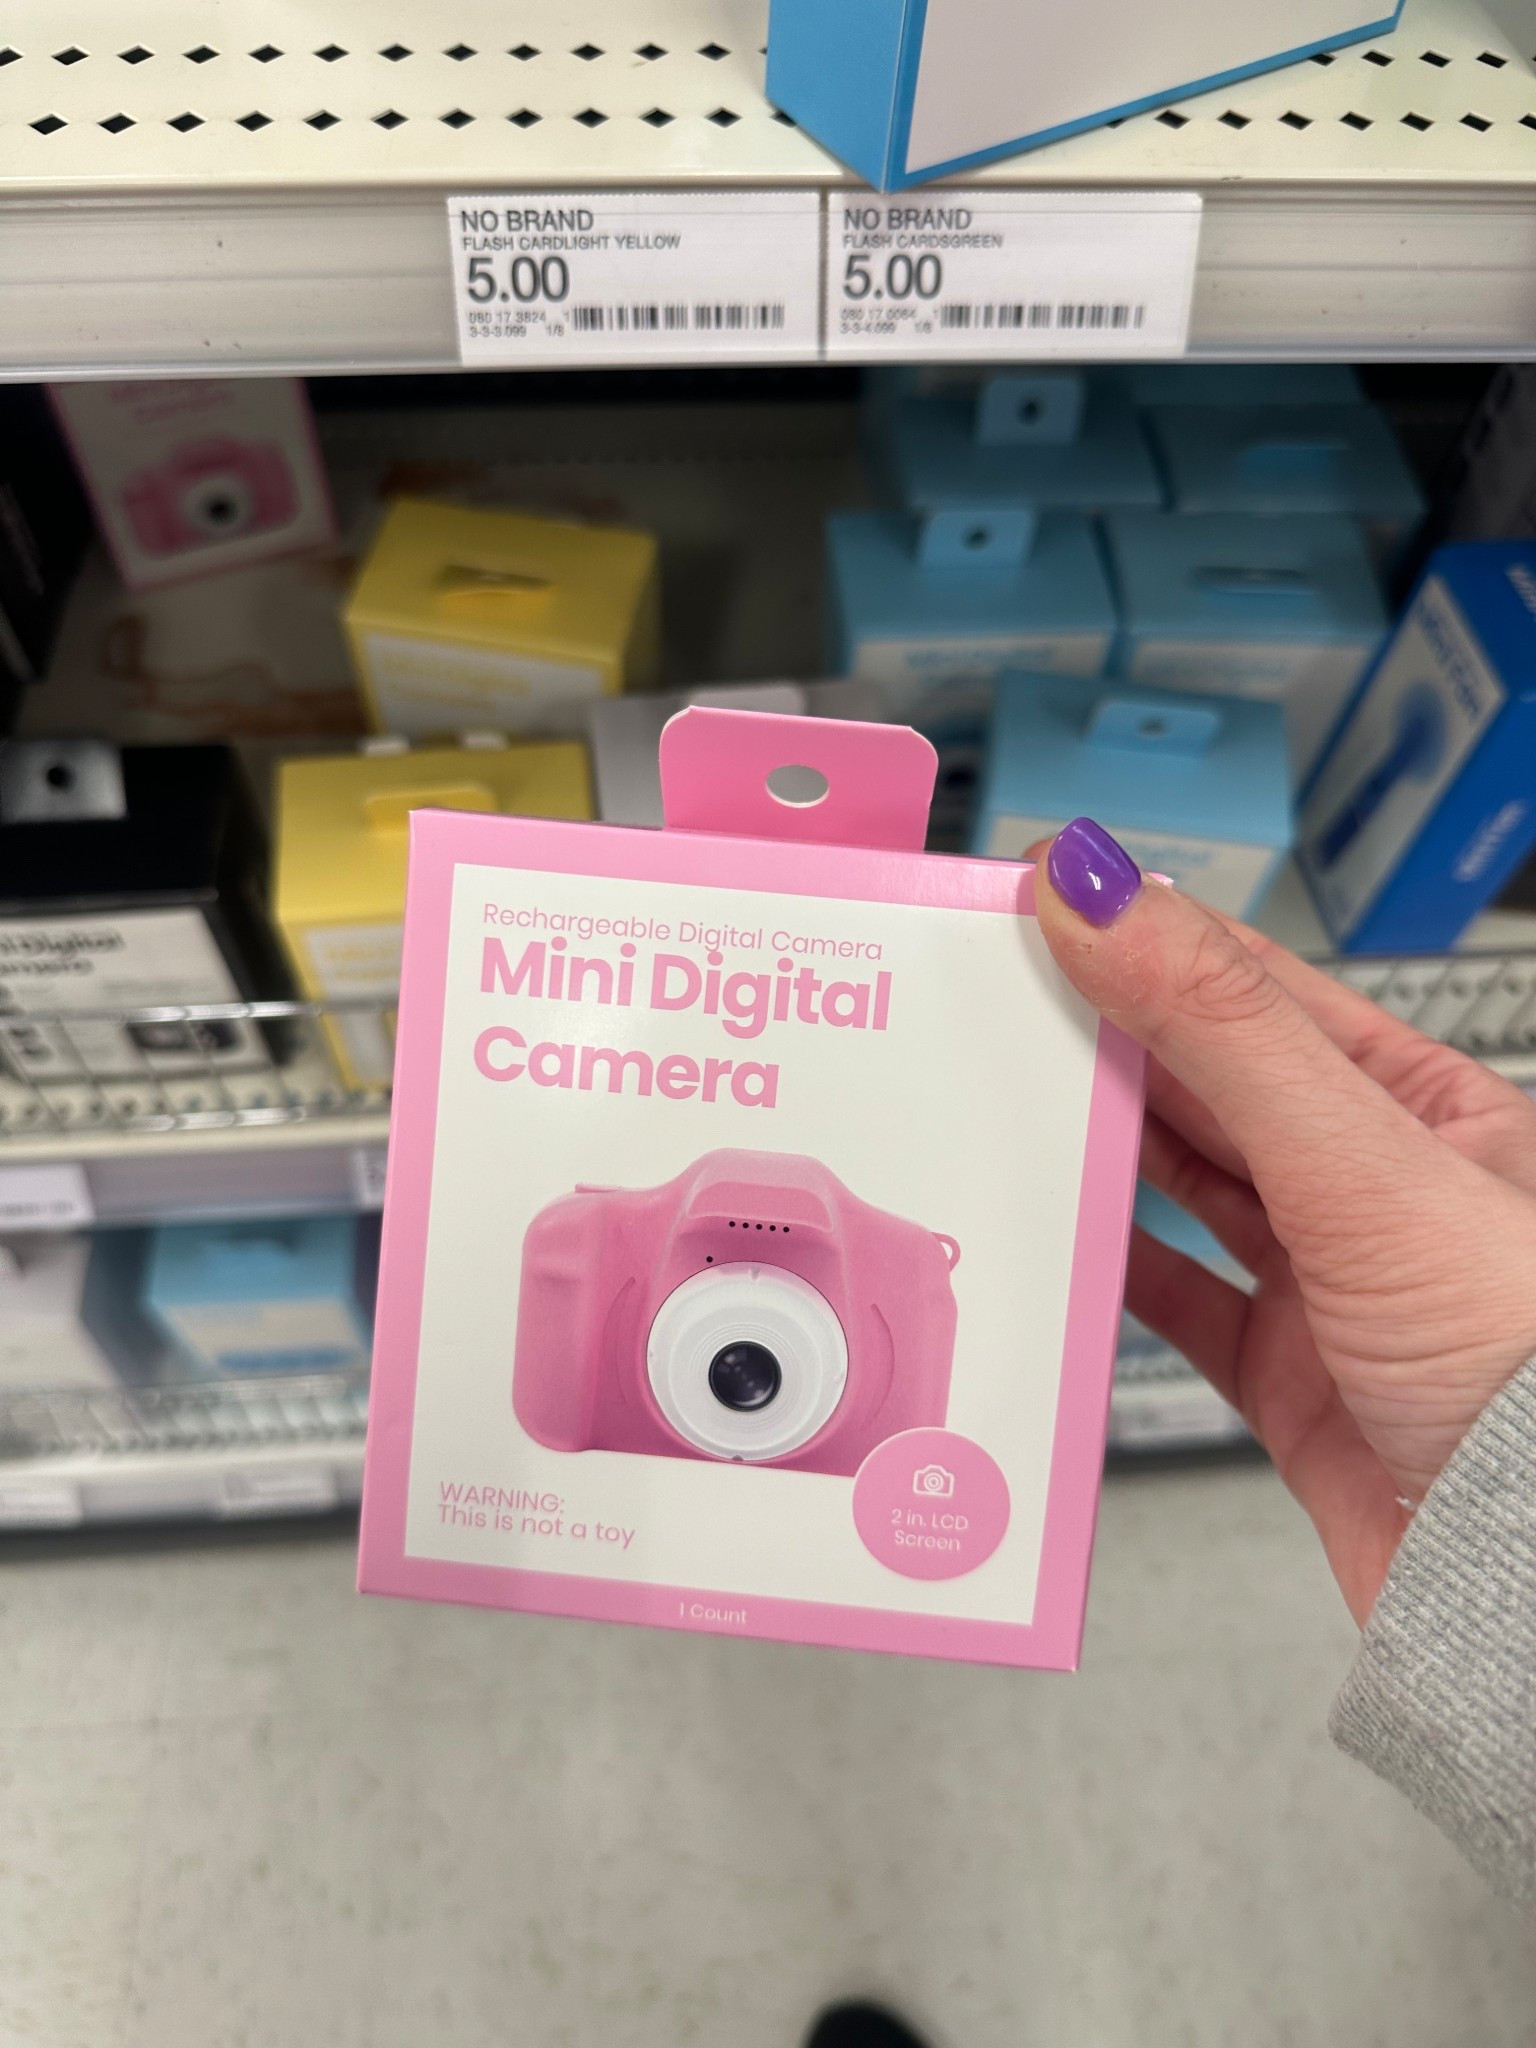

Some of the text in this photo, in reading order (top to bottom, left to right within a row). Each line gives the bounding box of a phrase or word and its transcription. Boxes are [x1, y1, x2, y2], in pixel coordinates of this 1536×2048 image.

[460, 209, 594, 232] NO BRAND
[844, 208, 972, 231] NO BRAND
[463, 235, 682, 251] FLASH CARDLIGHT YELLOW
[842, 233, 1004, 249] FLASH CARDSGREEN
[467, 255, 571, 303] 5.00
[843, 253, 942, 301] 5.00
[483, 903, 883, 960] Rechargeable Digital Camera
[480, 935, 893, 1040] Mini Digital
[473, 1025, 780, 1109] Camera
[440, 1480, 565, 1514] WARNING:
[438, 1503, 636, 1550] This is not a toy
[891, 1508, 902, 1524] 2
[931, 1512, 969, 1531] LCD
[894, 1529, 961, 1551] Screen
[690, 1603, 748, 1625] Count
